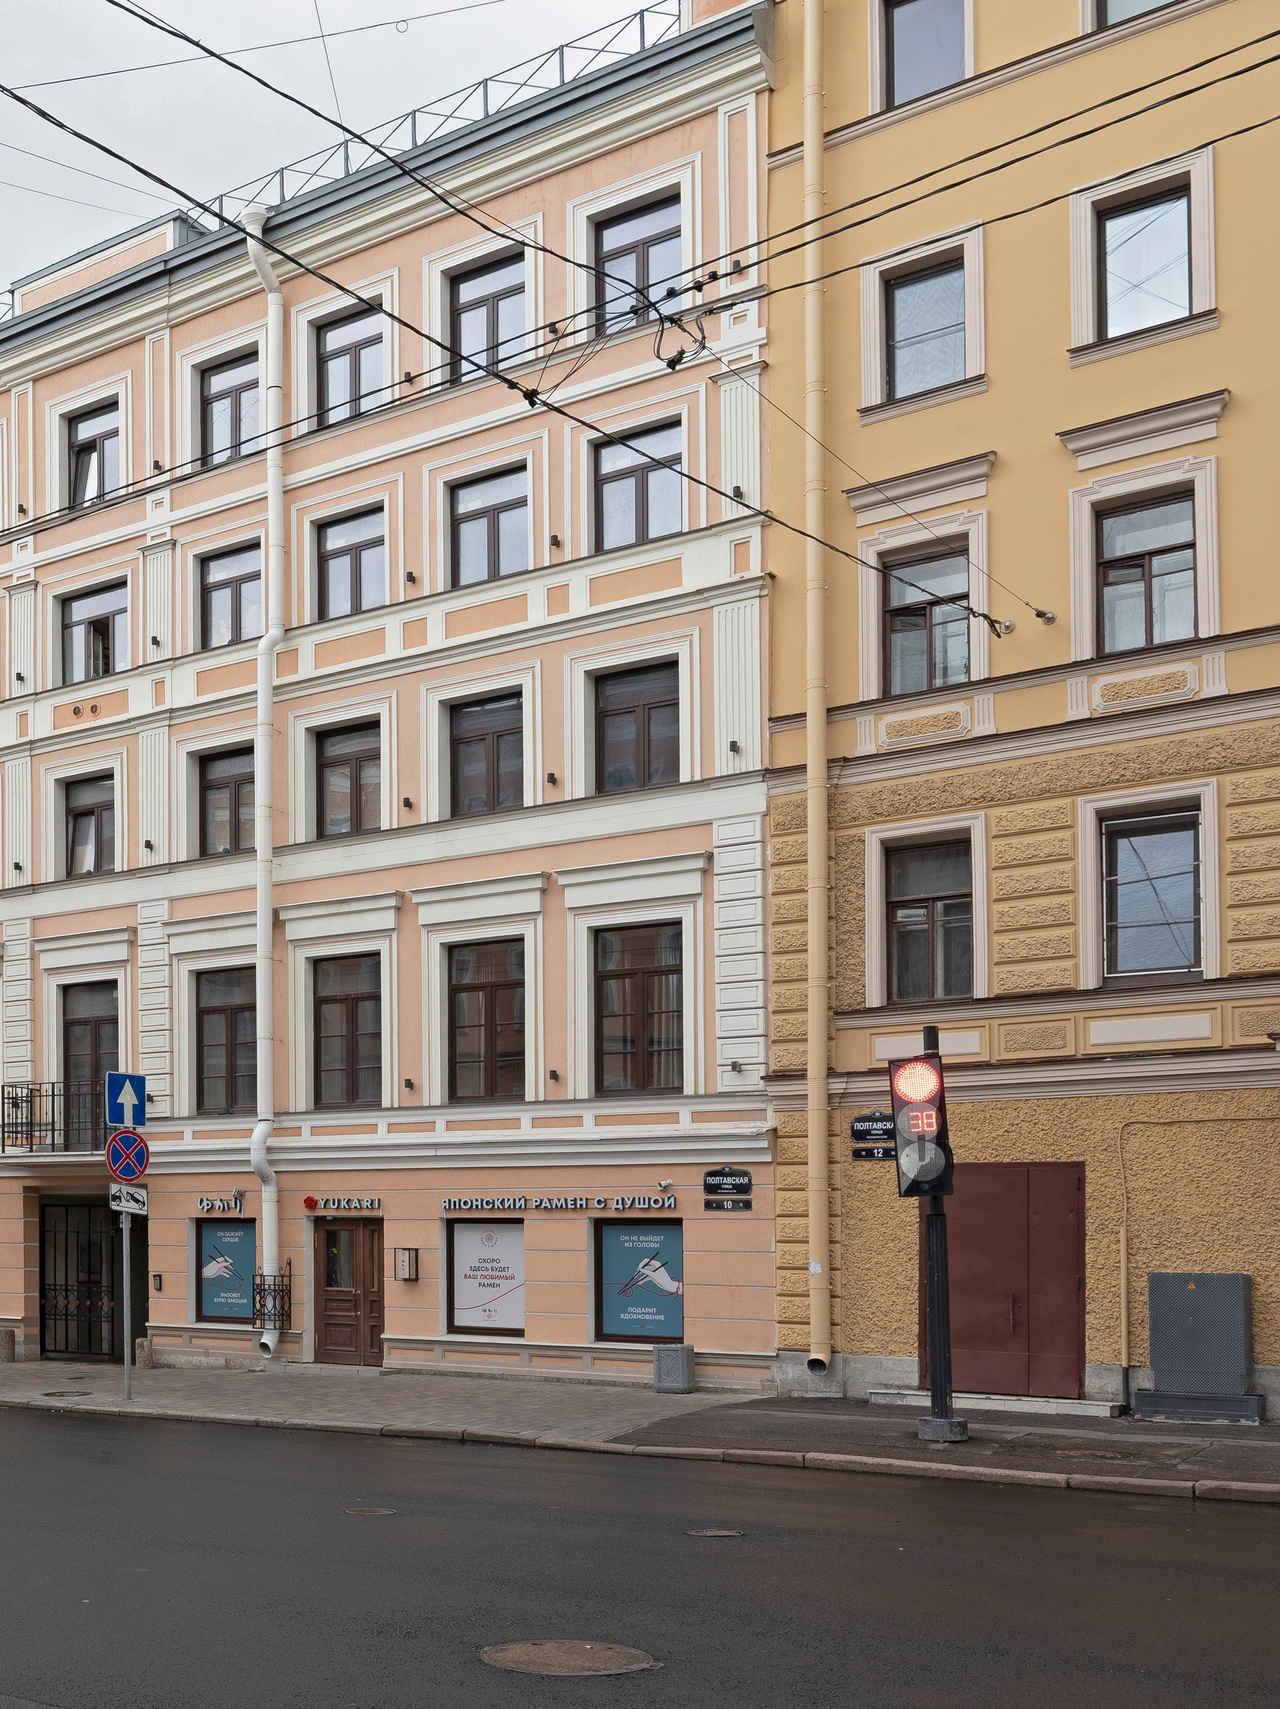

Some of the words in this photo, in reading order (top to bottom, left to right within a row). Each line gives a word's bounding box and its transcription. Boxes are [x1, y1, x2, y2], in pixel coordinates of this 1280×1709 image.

[909, 1110, 937, 1132] 38
[873, 1148, 883, 1157] 12
[706, 1176, 749, 1184] ПОЛТАВСКАЯ
[319, 1197, 380, 1210] YUKARI
[440, 1195, 526, 1210] ЯПОНСКИЙ
[532, 1197, 588, 1209] РАМЕН
[593, 1196, 606, 1208] С
[611, 1194, 676, 1210] ДУШОЙ
[723, 1200, 733, 1209] 10
[479, 1273, 516, 1281] ЛЮБИМЫЙ
